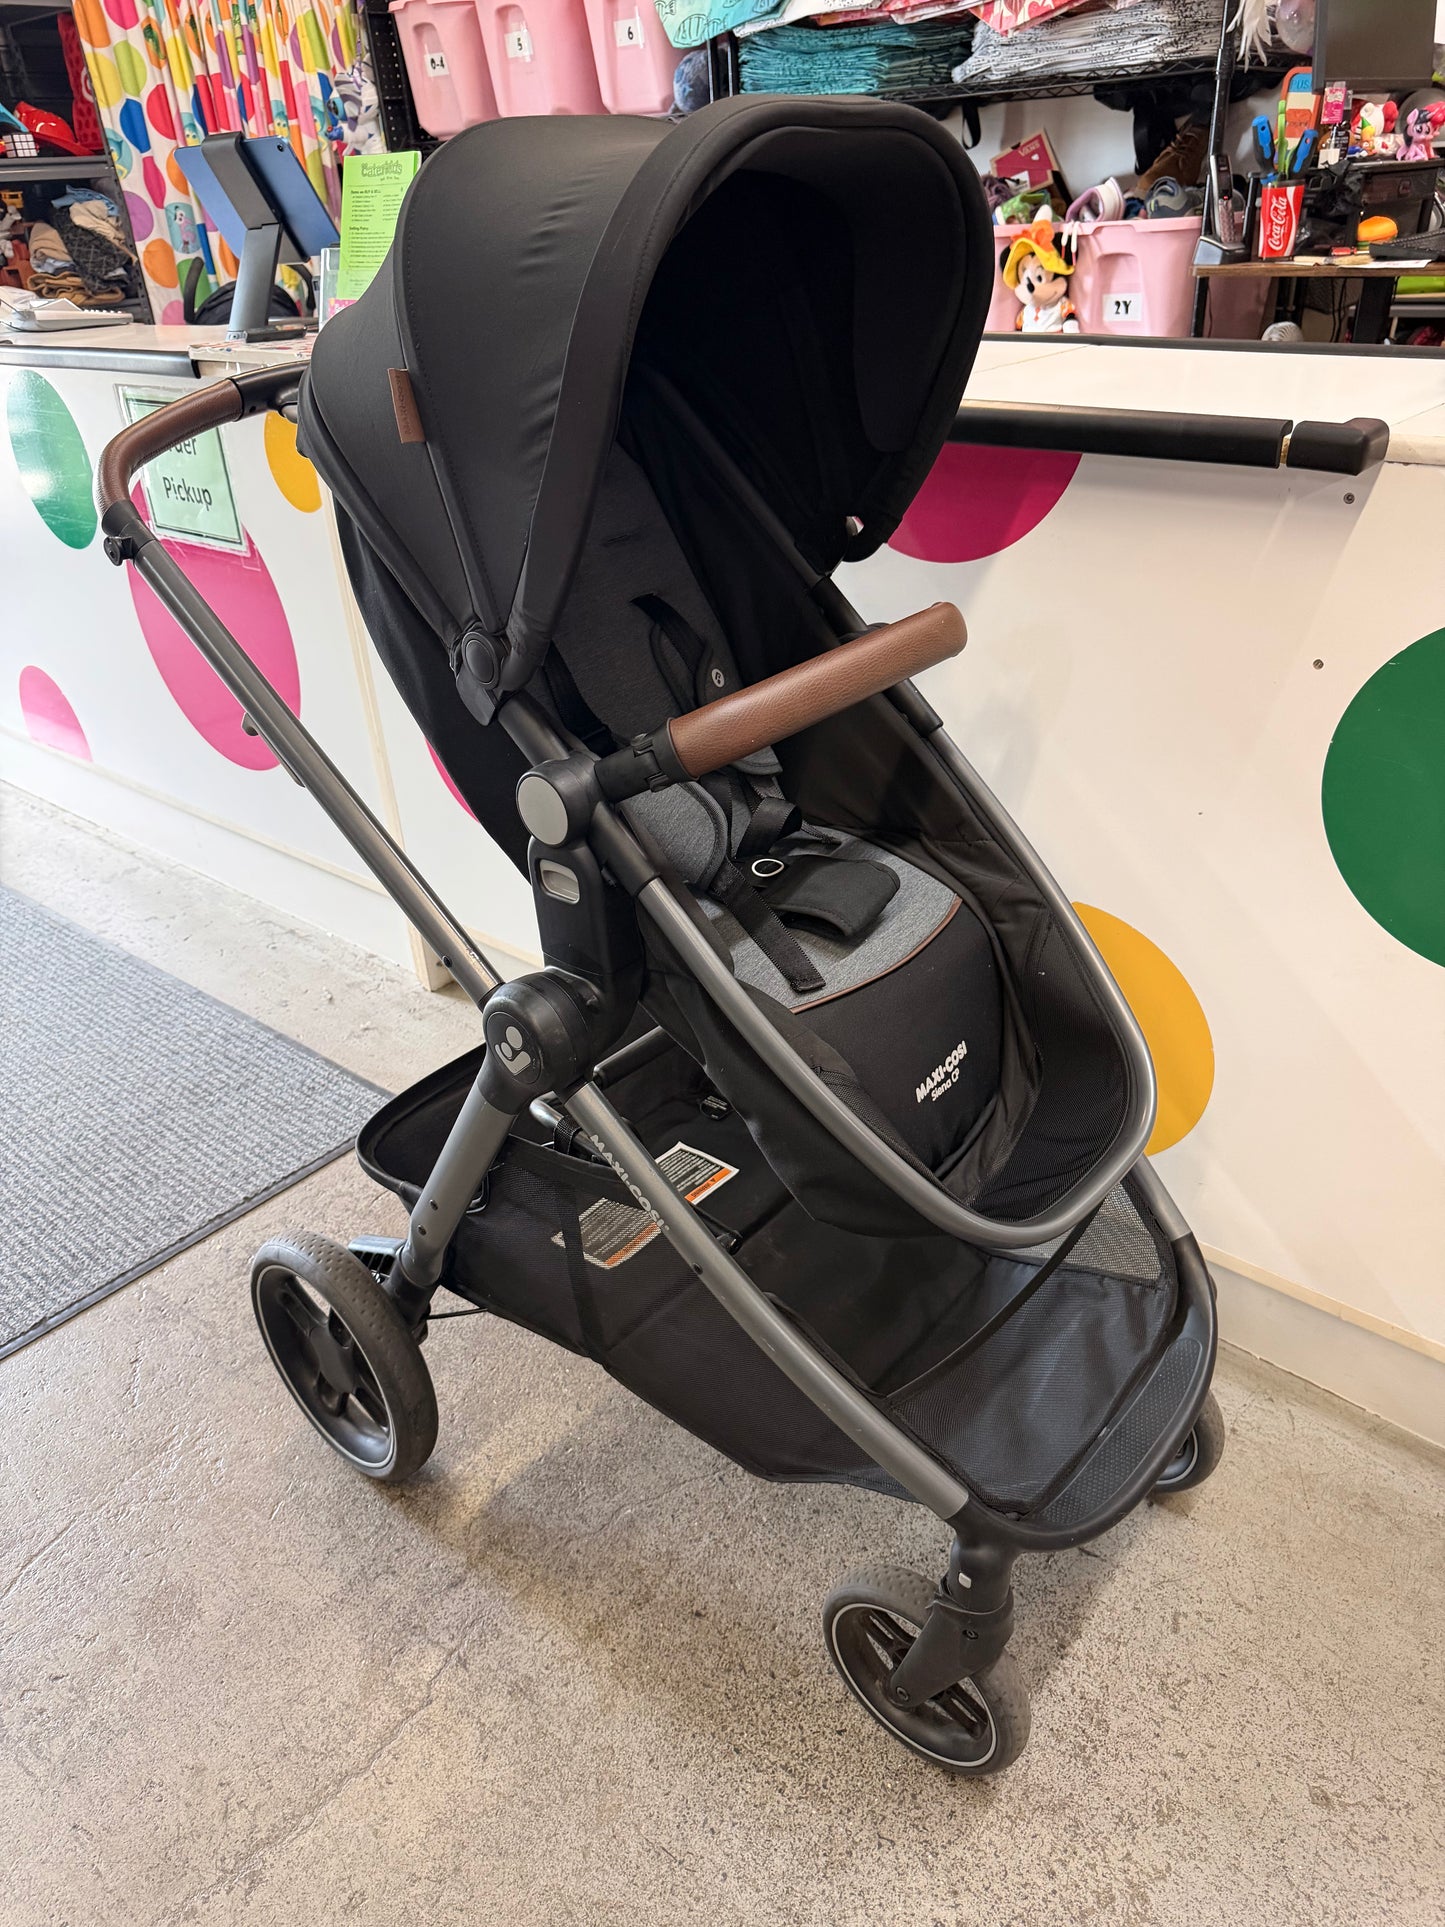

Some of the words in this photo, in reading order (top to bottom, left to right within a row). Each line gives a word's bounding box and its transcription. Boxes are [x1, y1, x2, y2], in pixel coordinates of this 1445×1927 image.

[517, 37, 523, 51] 5
[627, 26, 634, 40] 6
[1268, 195, 1287, 251] Coca-Cola
[1114, 300, 1132, 315] 2Y
[163, 476, 213, 511] Pickup
[915, 1040, 967, 1103] MAXI-COSI
[931, 1078, 952, 1101] Siena
[590, 1134, 665, 1227] MAXI-COSI
